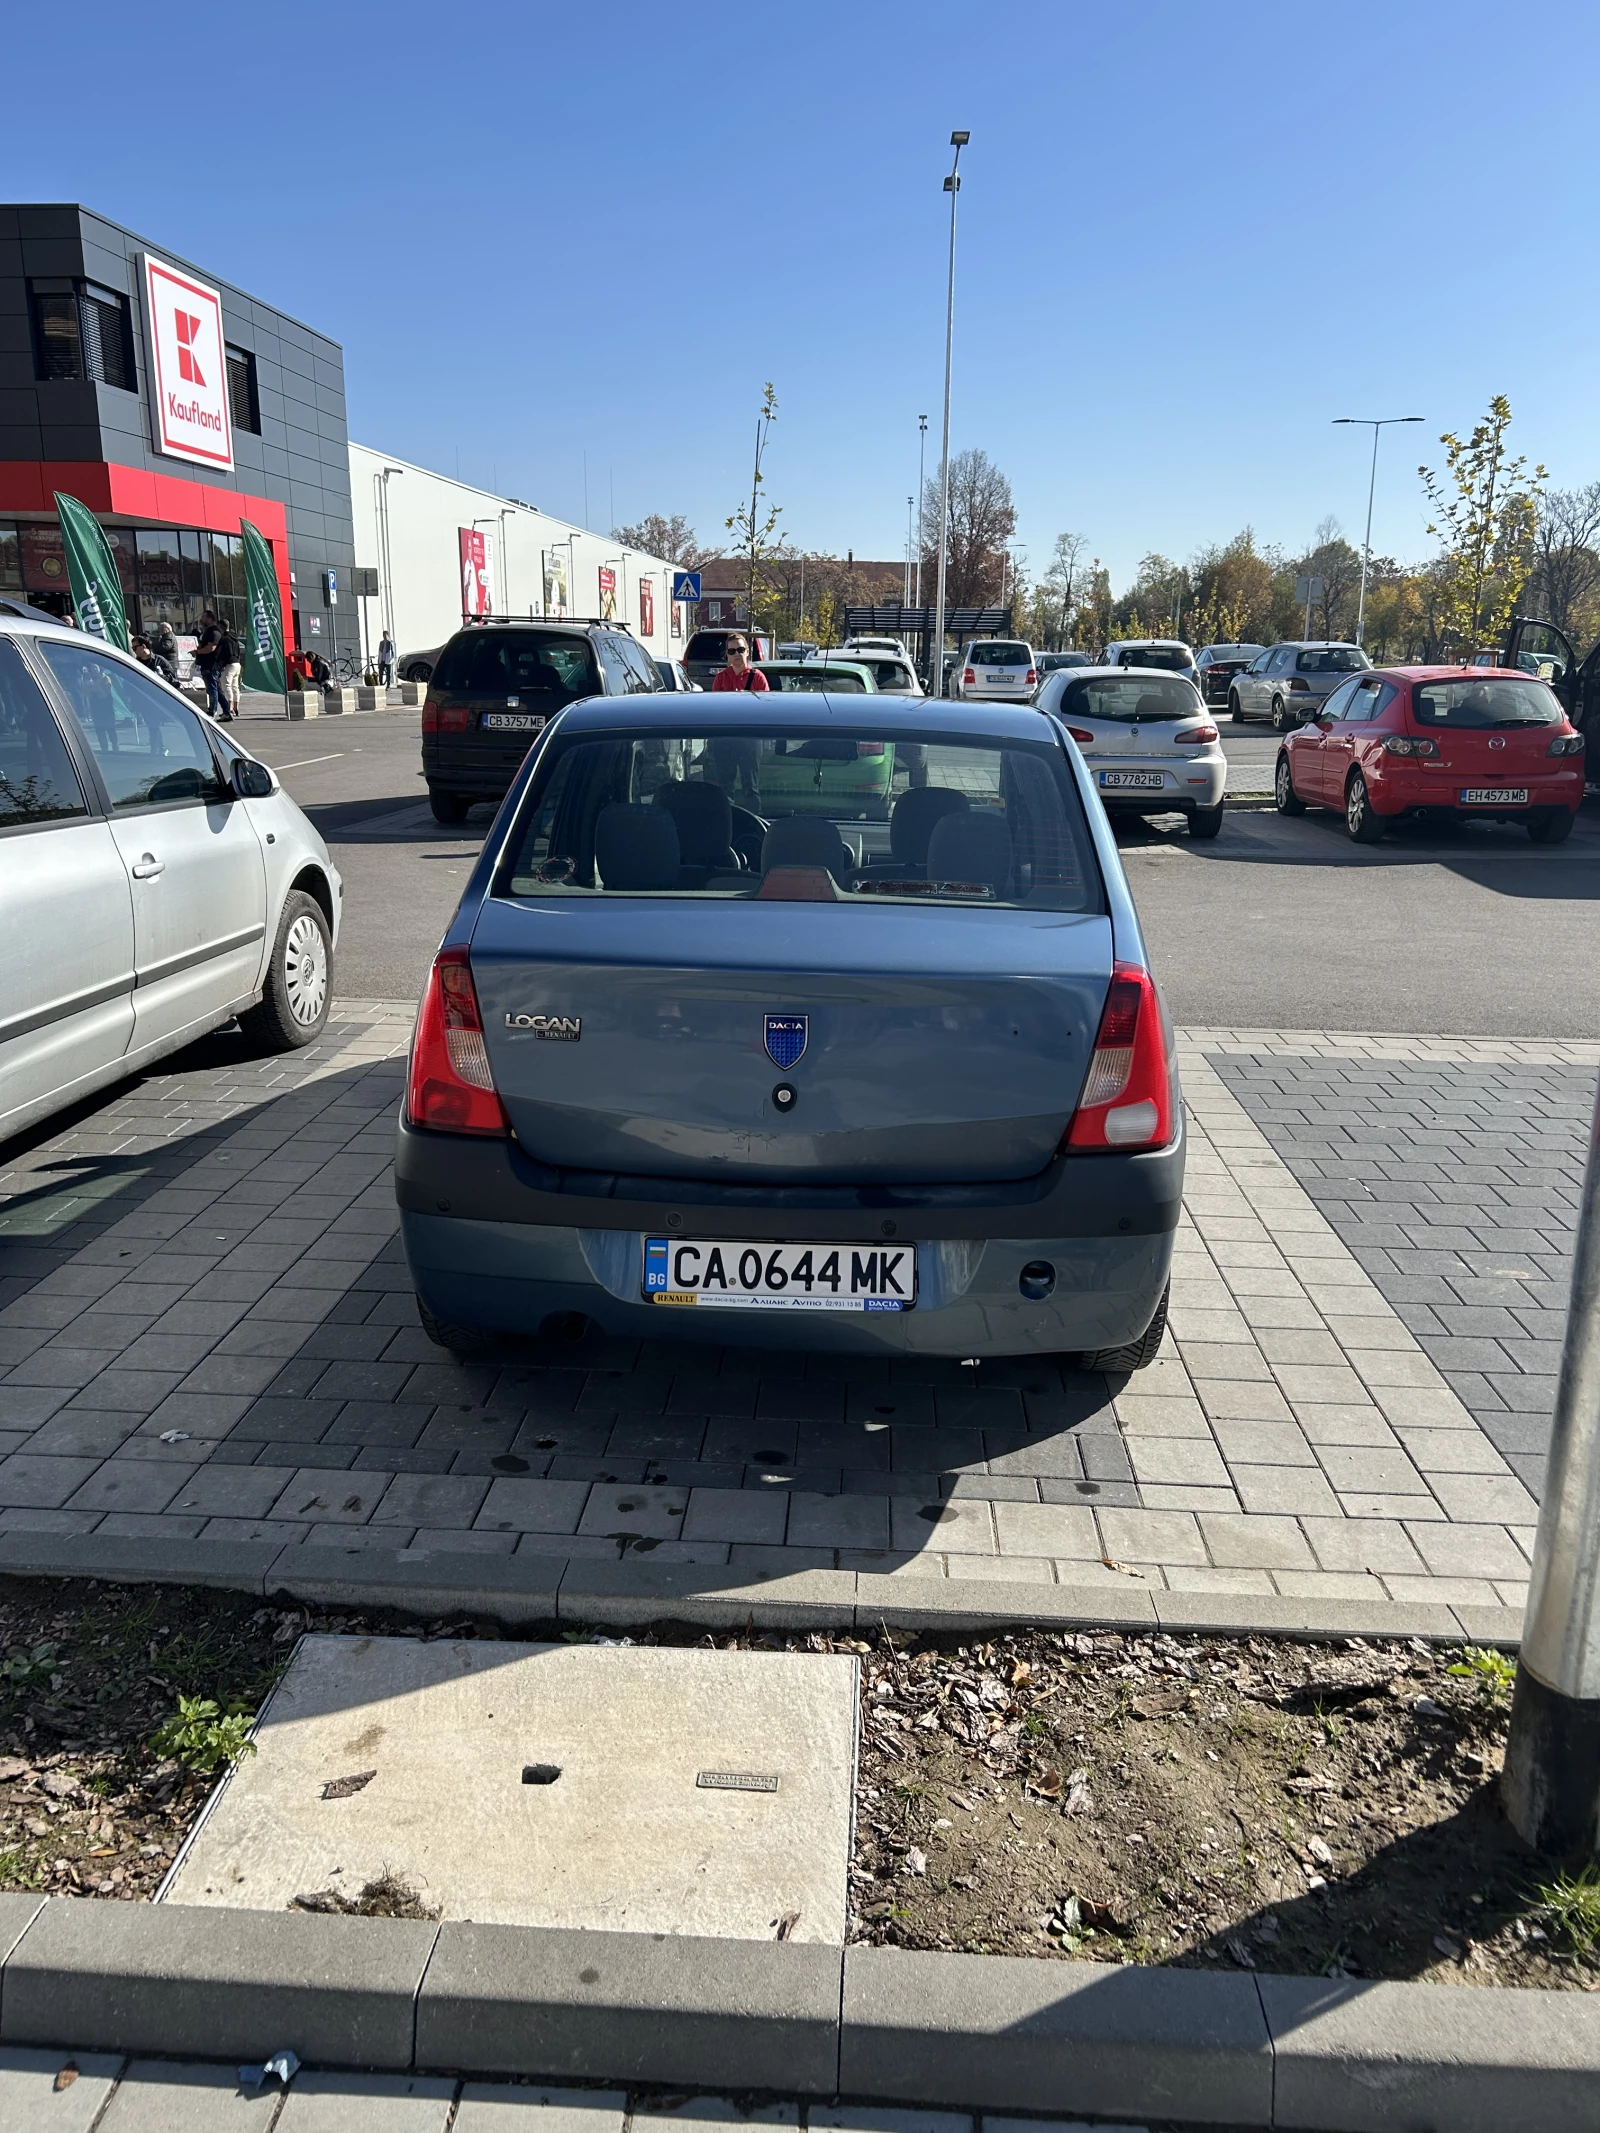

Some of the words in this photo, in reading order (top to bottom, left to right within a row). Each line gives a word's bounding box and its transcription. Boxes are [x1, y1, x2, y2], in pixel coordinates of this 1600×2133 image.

[168, 392, 221, 432] Kaufland
[489, 715, 503, 727] CB
[504, 716, 529, 727] 3757
[530, 717, 544, 728] ME
[1107, 774, 1120, 784] CB
[1122, 774, 1147, 785] 7782
[1148, 775, 1162, 785] HB
[1468, 790, 1482, 801] EH
[1484, 791, 1510, 801] 4573
[1511, 790, 1526, 801] MB
[505, 1013, 580, 1032] LOGAN
[768, 1022, 804, 1030] DACIA
[544, 1031, 576, 1039] RENAULT
[674, 1246, 727, 1288] CA
[738, 1249, 841, 1292] 0644
[851, 1251, 904, 1294] MK
[648, 1272, 665, 1286] BG
[658, 1294, 695, 1303] RENAULT
